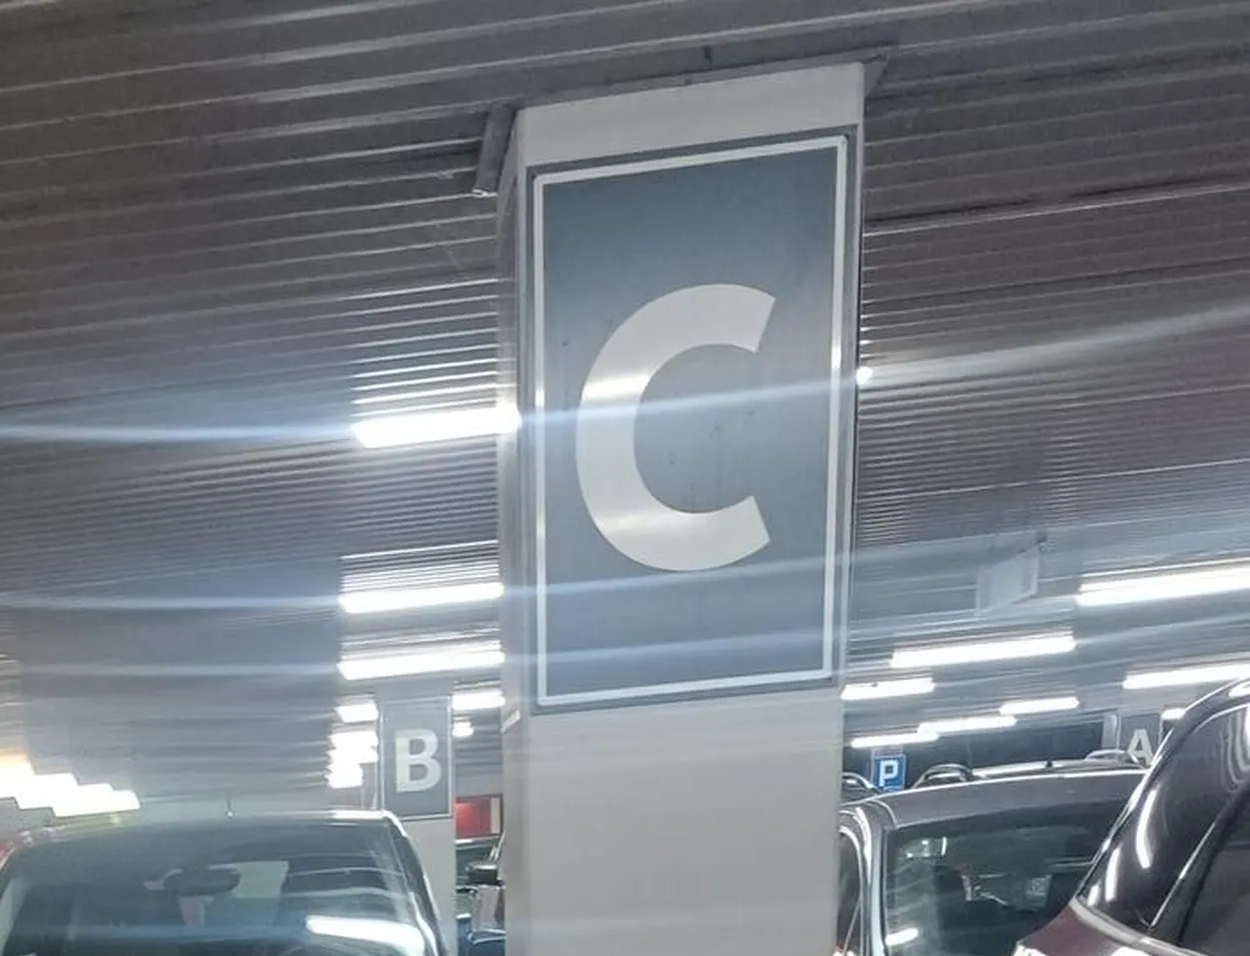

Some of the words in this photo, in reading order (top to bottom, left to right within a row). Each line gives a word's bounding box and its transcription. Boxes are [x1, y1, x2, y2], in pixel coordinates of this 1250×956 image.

[574, 283, 776, 571] C
[395, 728, 442, 793] B
[1126, 728, 1153, 766] A
[878, 759, 899, 787] P
